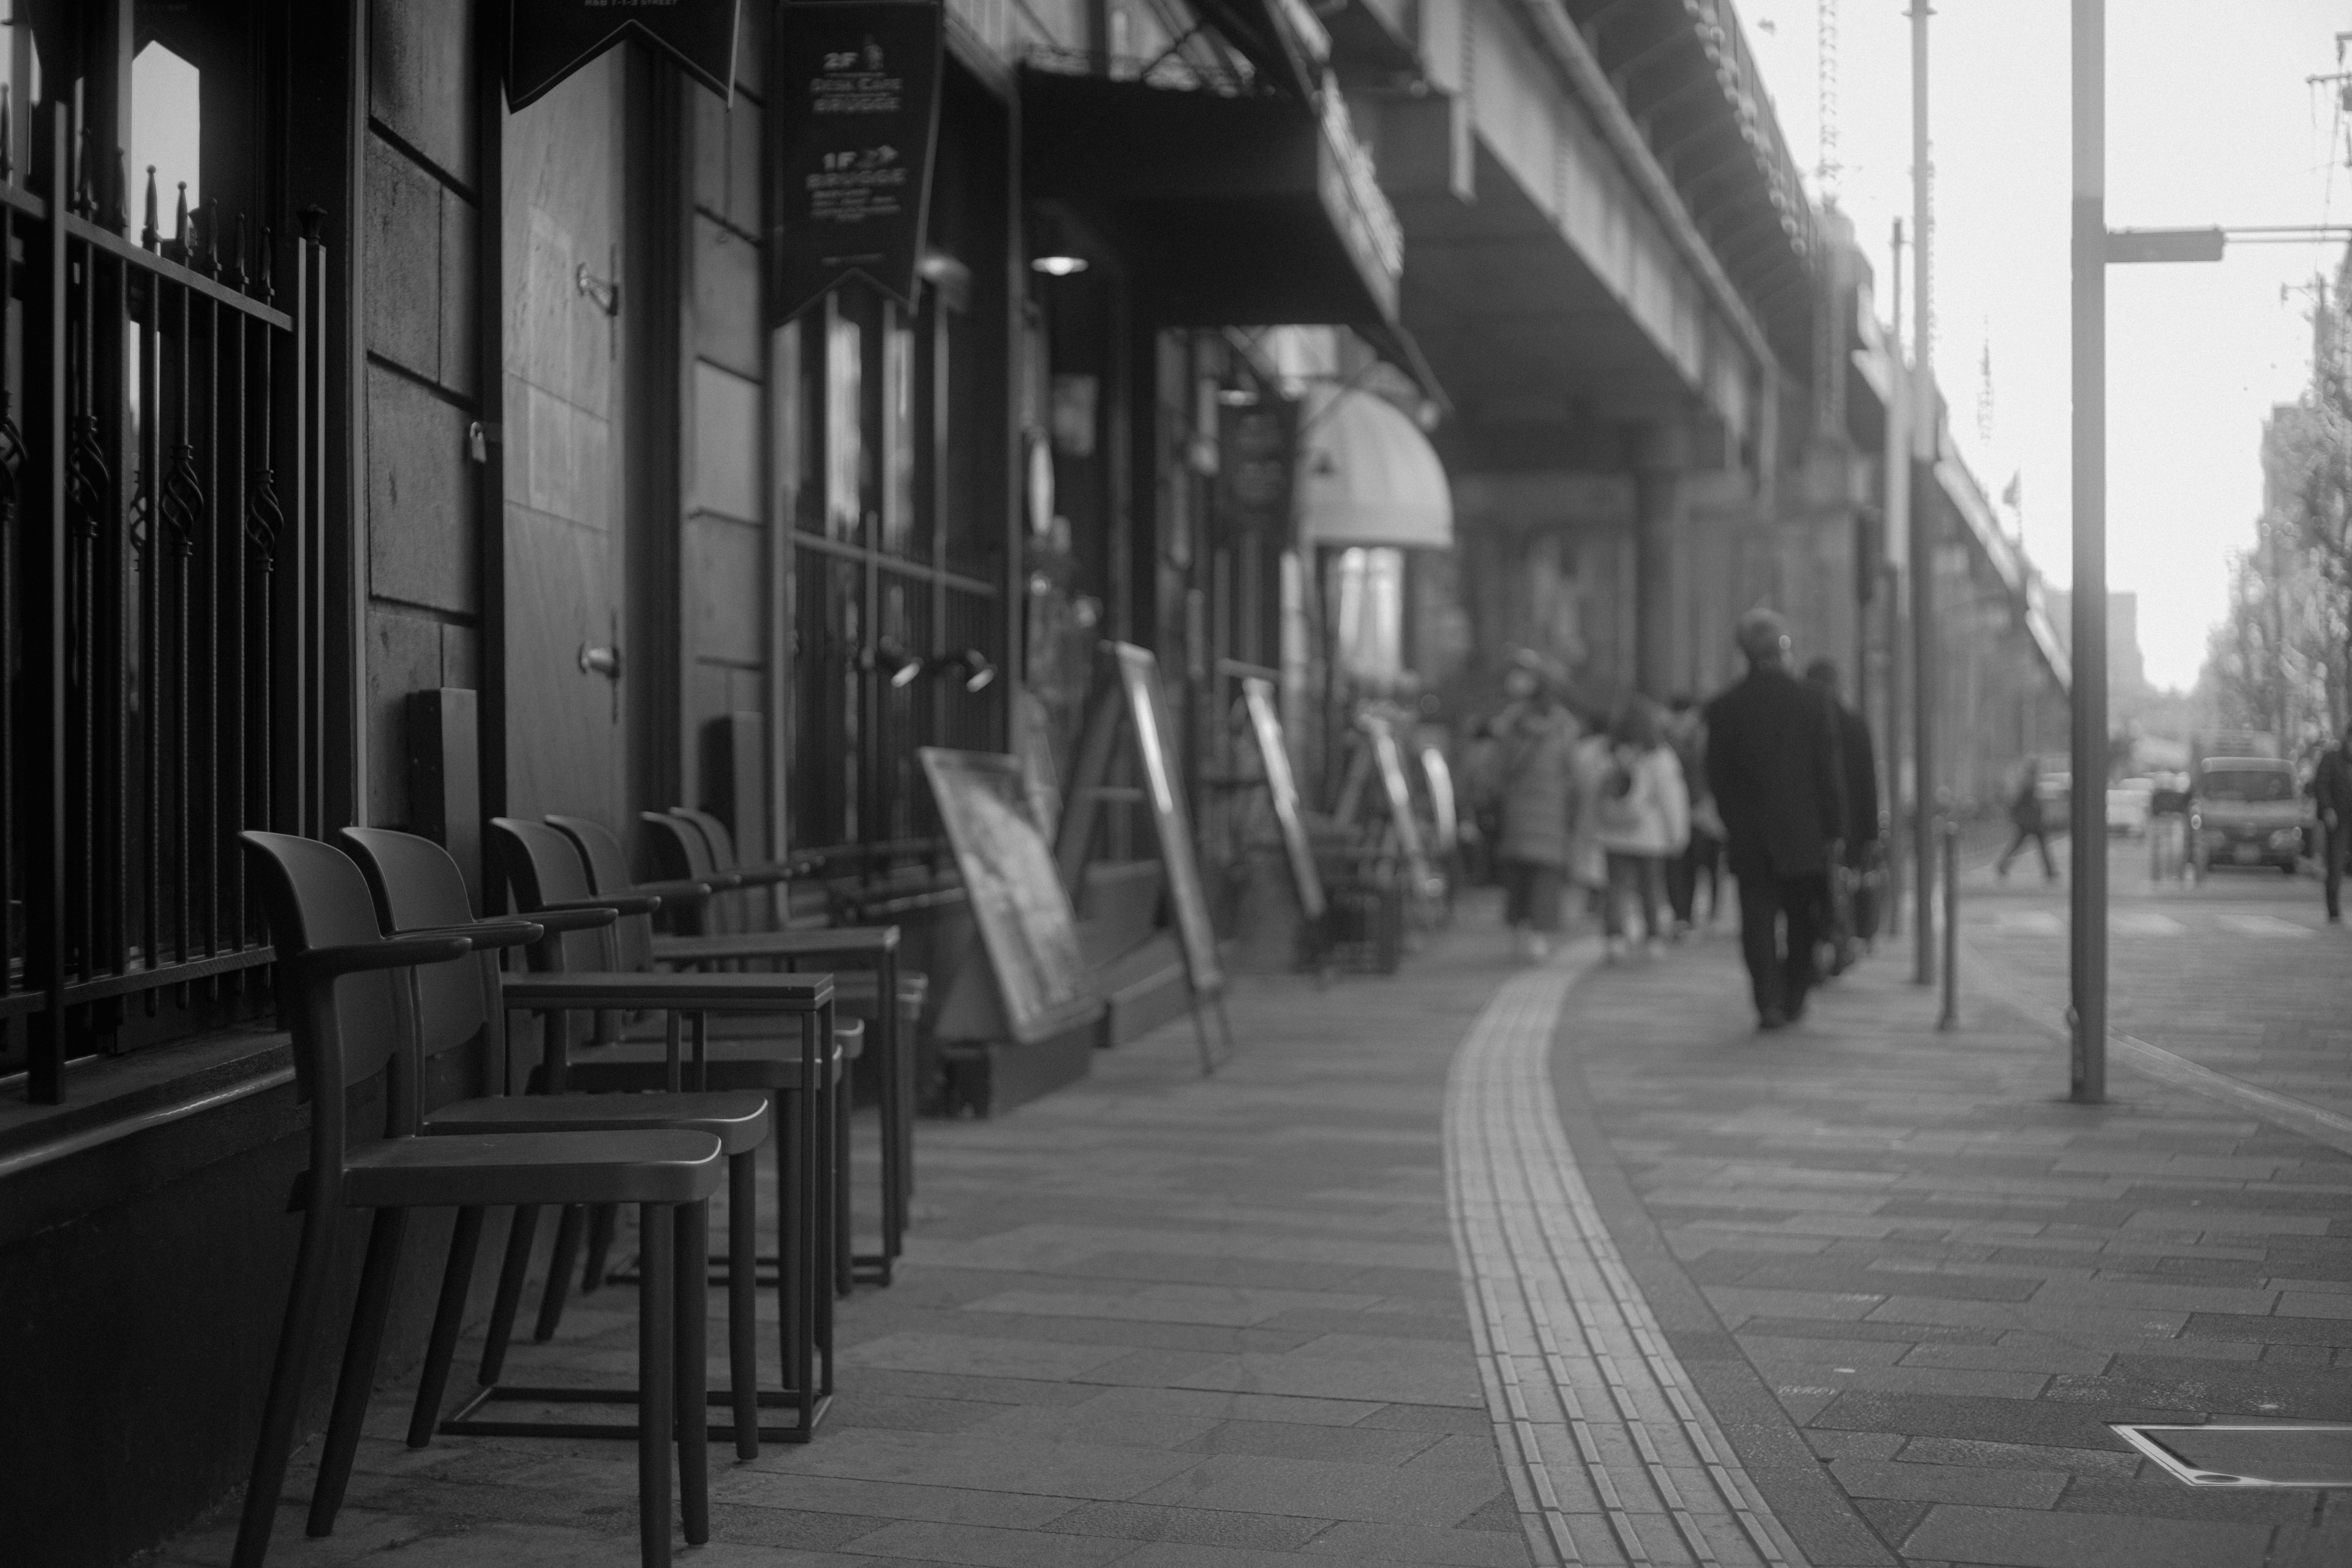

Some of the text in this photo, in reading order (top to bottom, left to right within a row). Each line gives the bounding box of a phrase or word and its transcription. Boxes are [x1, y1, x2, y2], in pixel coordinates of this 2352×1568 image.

[823, 51, 859, 69] 2F
[823, 151, 857, 171] 1F
[806, 168, 907, 190] BRUGGE
